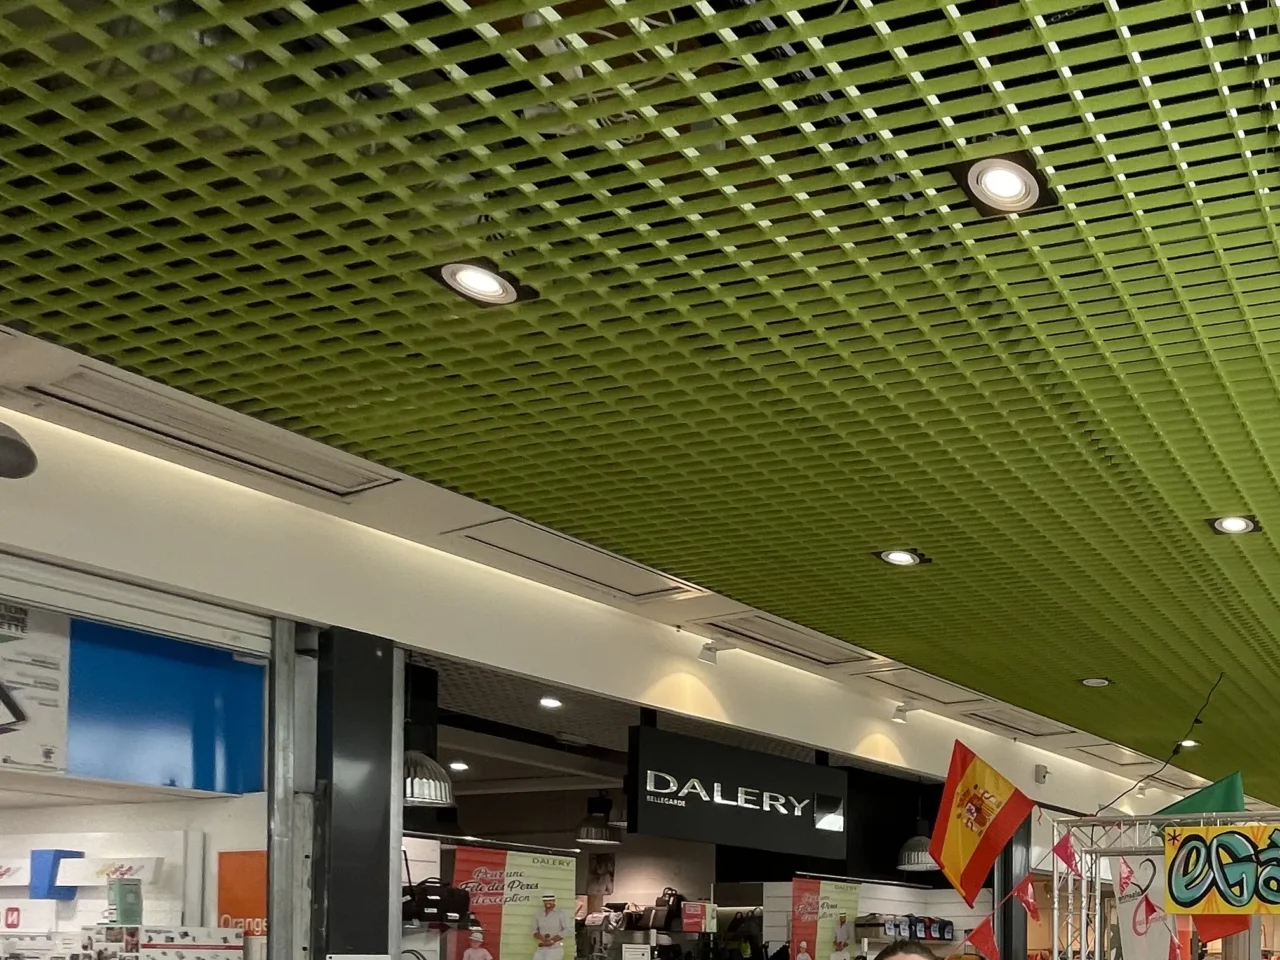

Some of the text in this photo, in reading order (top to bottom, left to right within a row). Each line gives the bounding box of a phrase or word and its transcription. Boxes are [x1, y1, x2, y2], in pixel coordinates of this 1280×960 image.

[646, 769, 811, 817] DALERY
[646, 794, 686, 808] BELLEGARDE
[532, 857, 572, 867] DALERY
